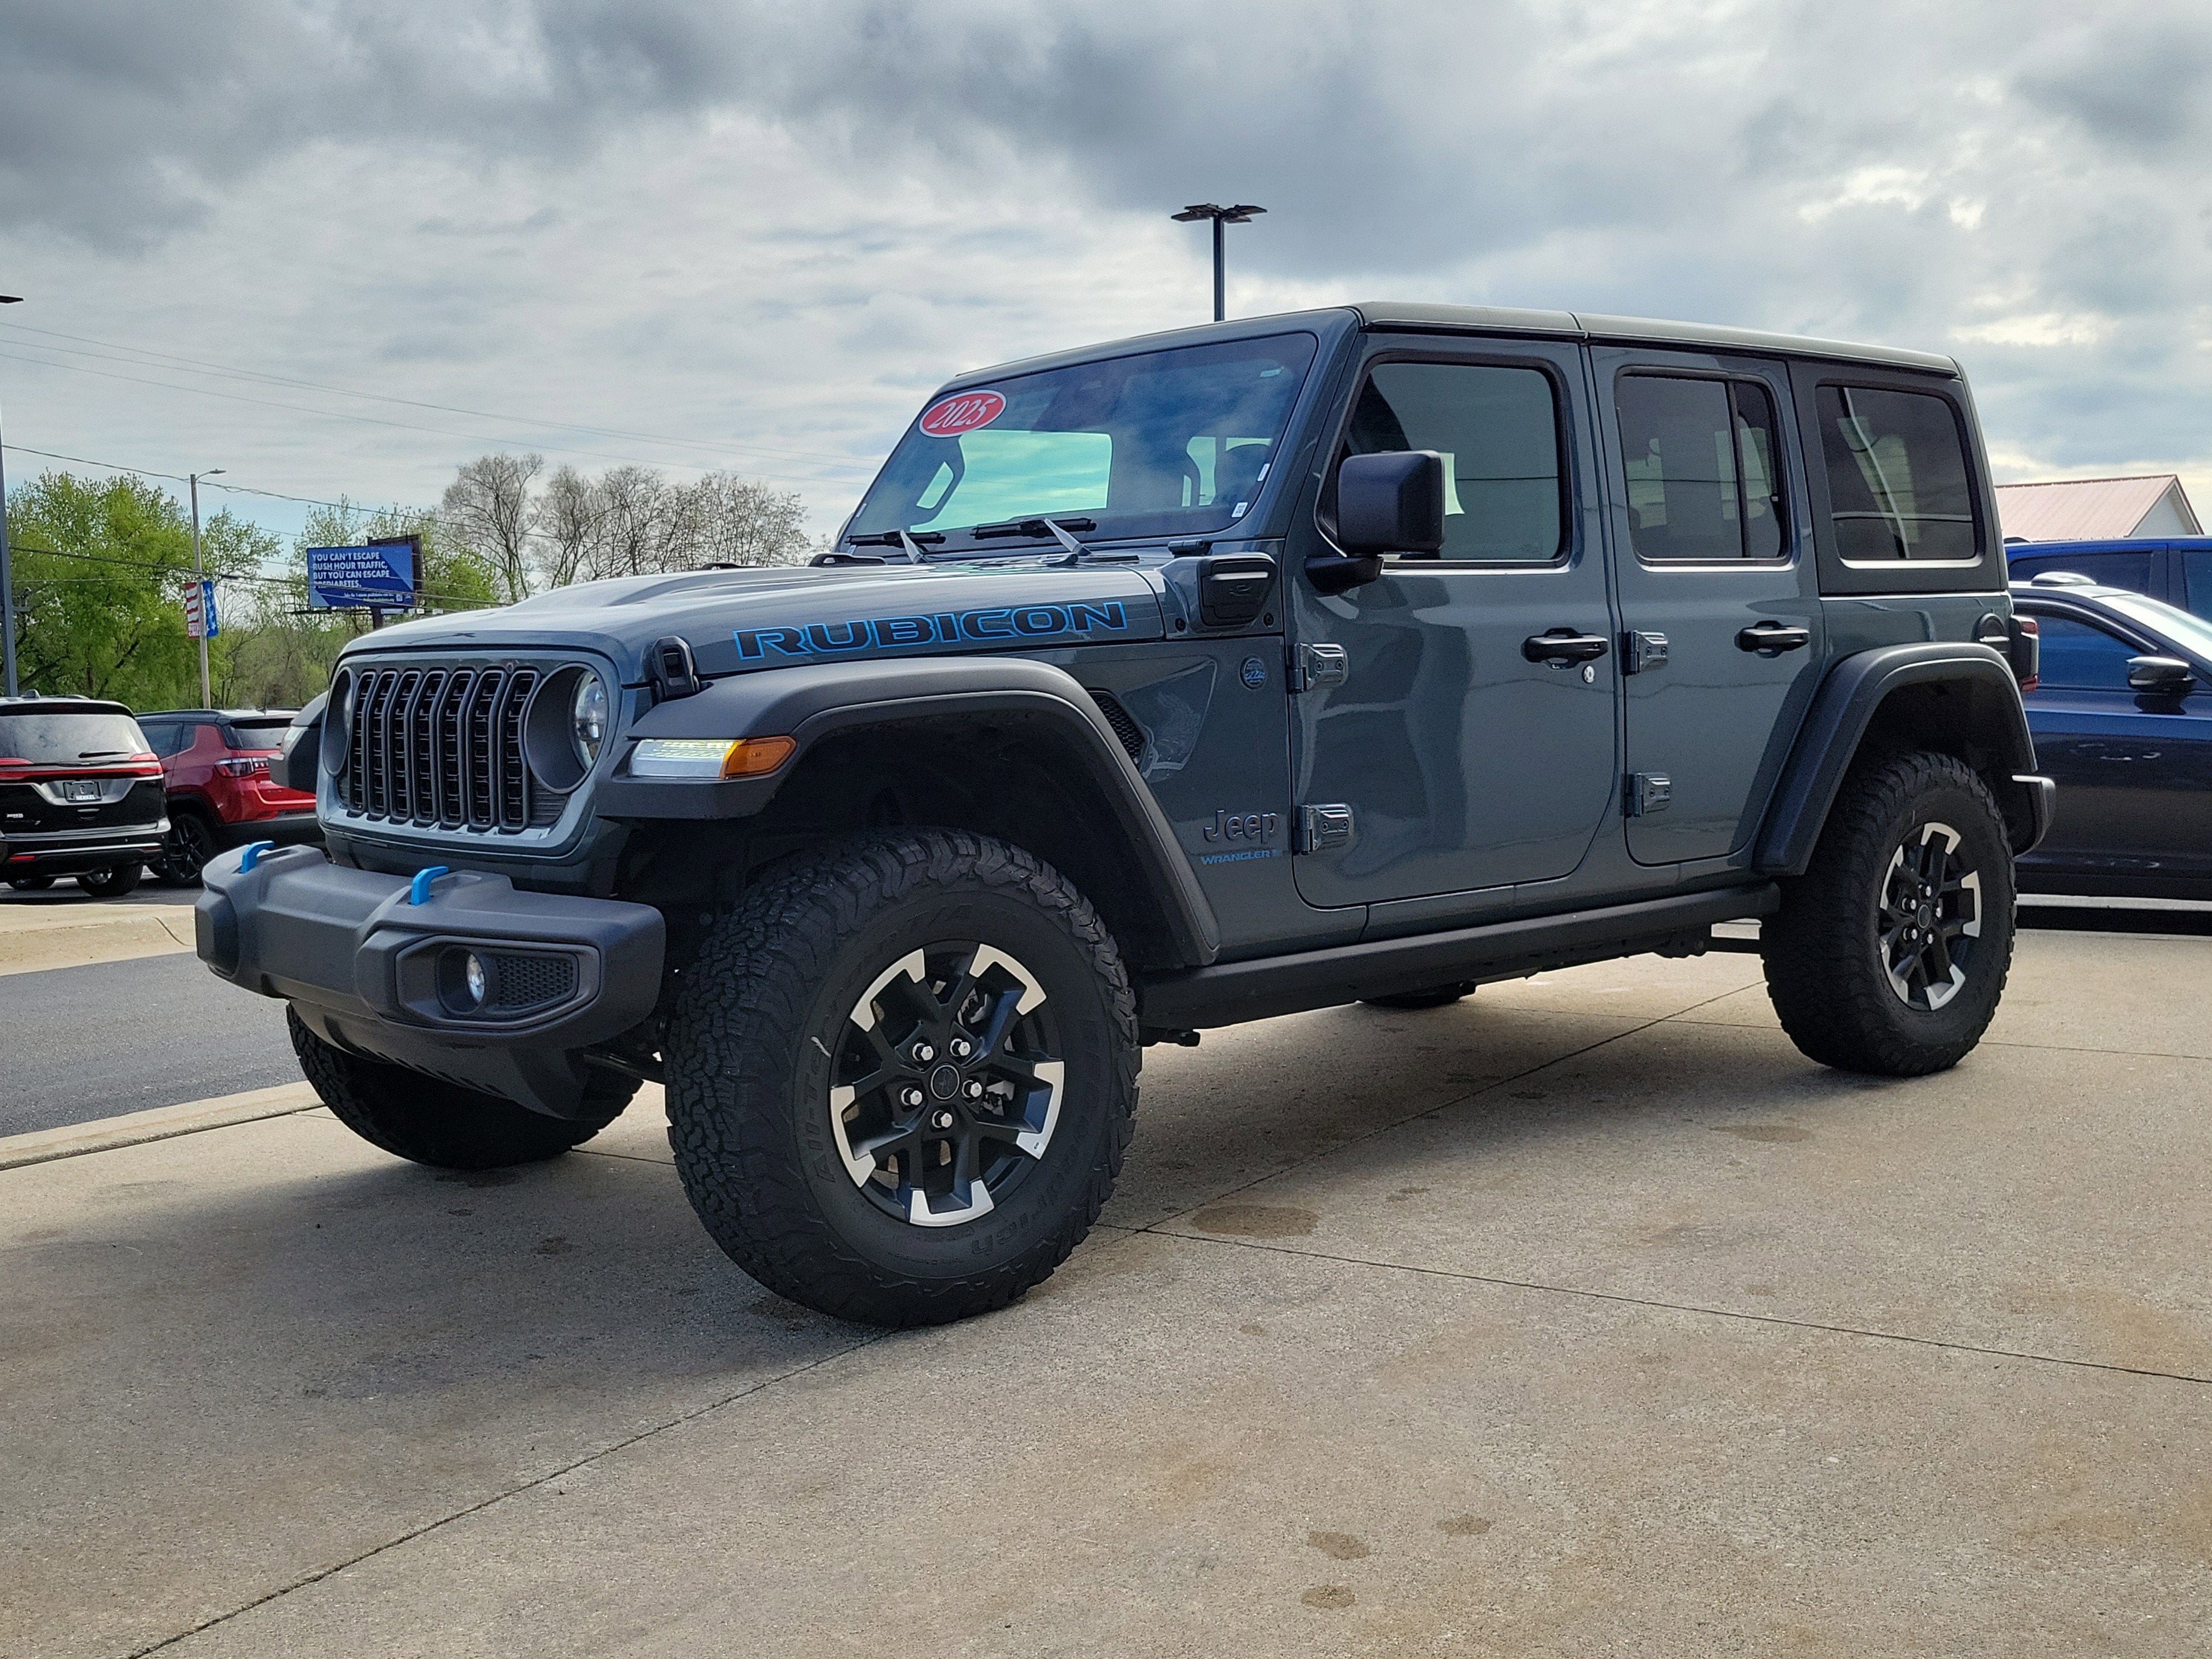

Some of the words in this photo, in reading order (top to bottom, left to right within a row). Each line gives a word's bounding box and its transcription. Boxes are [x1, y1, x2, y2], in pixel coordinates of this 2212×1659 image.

[927, 398, 997, 429] 2025
[330, 552, 352, 561] CAN'T
[334, 561, 356, 569] HOUR
[357, 561, 388, 569] TRAFFIC,
[328, 571, 344, 579] YOU
[346, 570, 362, 578] CAN
[363, 569, 390, 578] ESCAPE
[732, 601, 1127, 660] RUBICON
[1204, 810, 1279, 844] Jeep
[1201, 850, 1271, 865] WRANGLER
